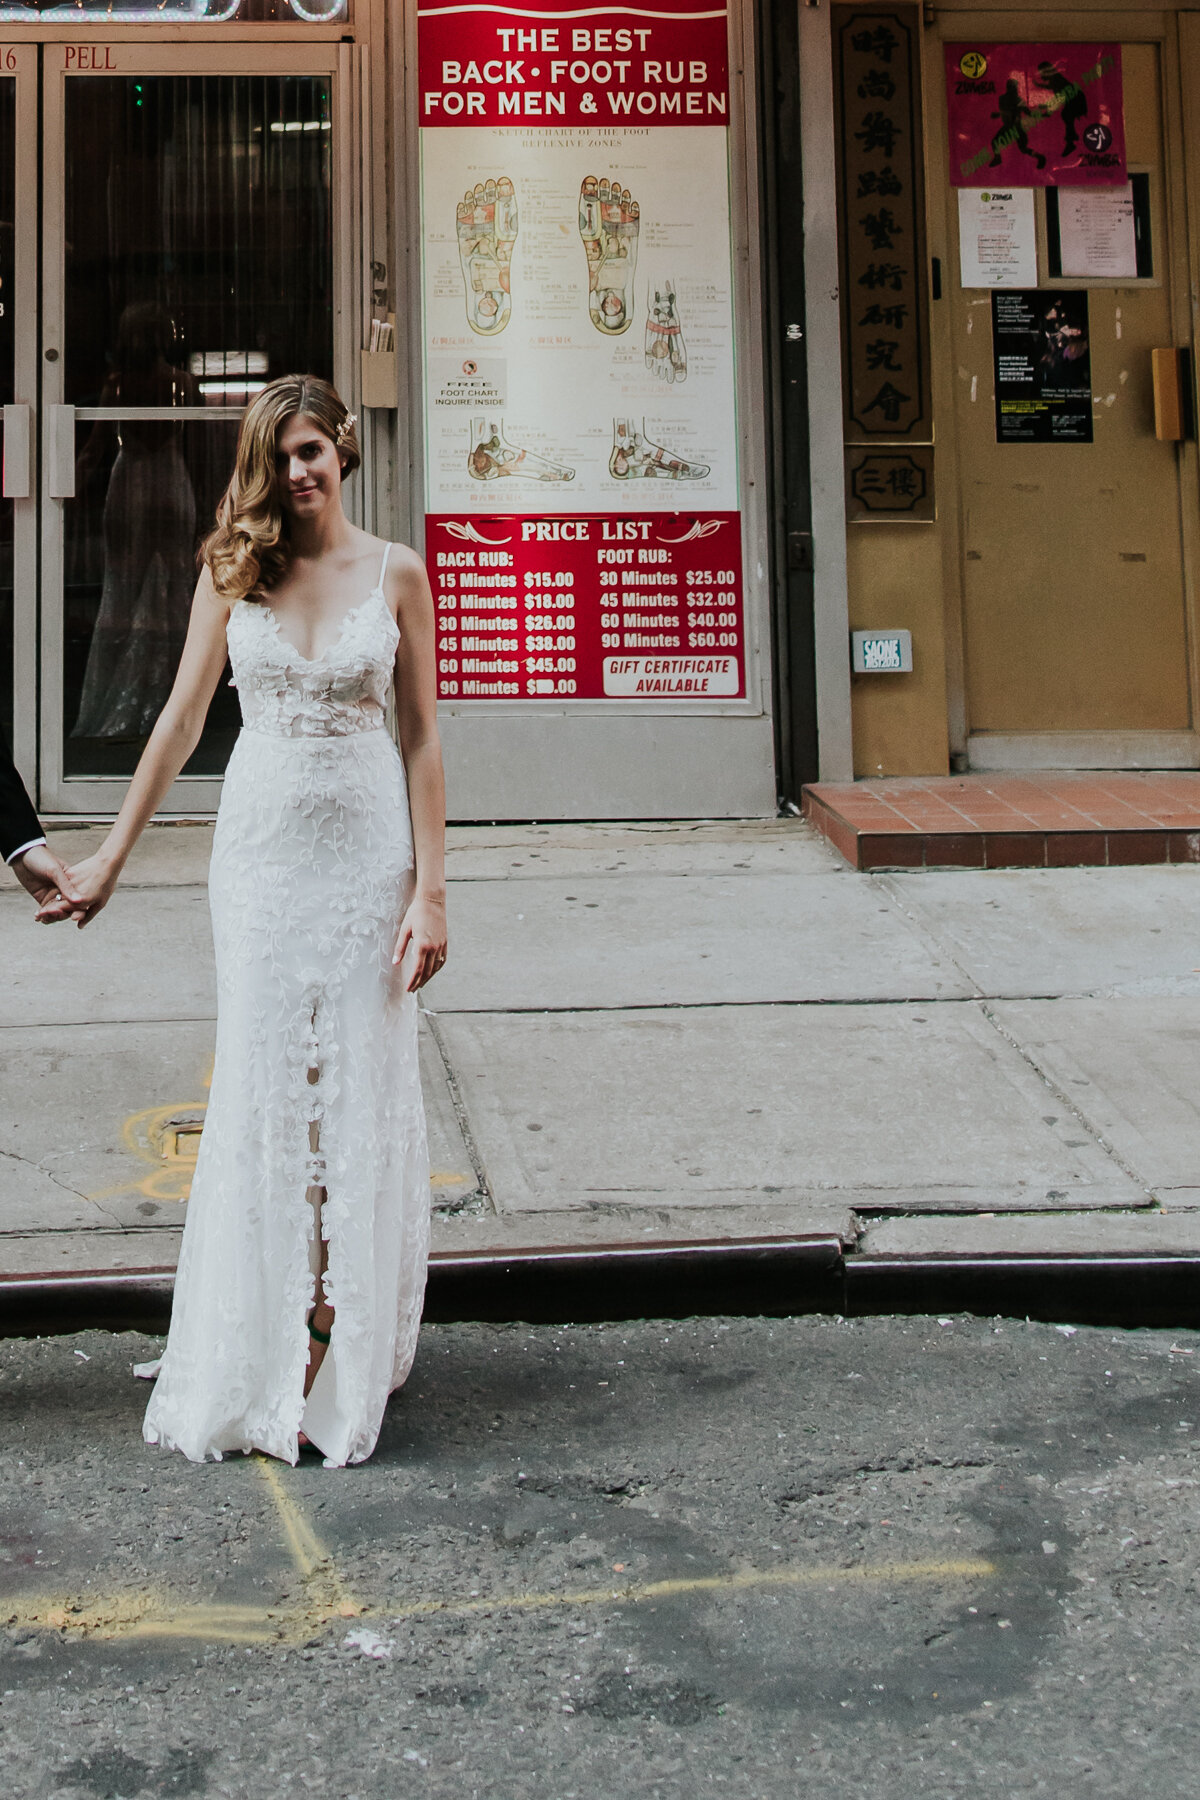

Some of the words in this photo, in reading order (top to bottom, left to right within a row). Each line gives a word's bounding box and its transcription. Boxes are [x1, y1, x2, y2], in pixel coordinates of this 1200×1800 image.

[496, 28, 560, 52] THE
[571, 28, 652, 52] BEST
[63, 45, 117, 70] PELL
[643, 60, 708, 84] RUB
[424, 91, 487, 115] FOR
[497, 91, 566, 115] MEN
[579, 91, 598, 115] &
[607, 91, 727, 115] WOMEN
[623, 128, 651, 136] FOOT
[468, 389, 499, 397] CHART
[435, 398, 472, 406] INQUIRE
[474, 398, 505, 406] INSIDE
[860, 468, 917, 497] 三樓
[520, 521, 590, 541] PRICE
[601, 521, 653, 540] LIST
[436, 551, 476, 567] BACK
[478, 551, 514, 567] RUB:
[597, 548, 635, 564] FOOT
[638, 548, 673, 563] RUB:
[437, 573, 456, 588] 15
[459, 572, 517, 588] Minutes
[523, 571, 575, 589] $15.00
[599, 571, 618, 586] 30
[621, 570, 678, 586] Minutes
[685, 570, 736, 586] $25.00
[601, 633, 620, 648] 90
[623, 632, 681, 648] Minutes
[688, 632, 738, 648] $60.00
[610, 660, 640, 674] GIFT
[644, 659, 730, 674] CERTIFICATE
[635, 678, 709, 692] AVAILABLE
